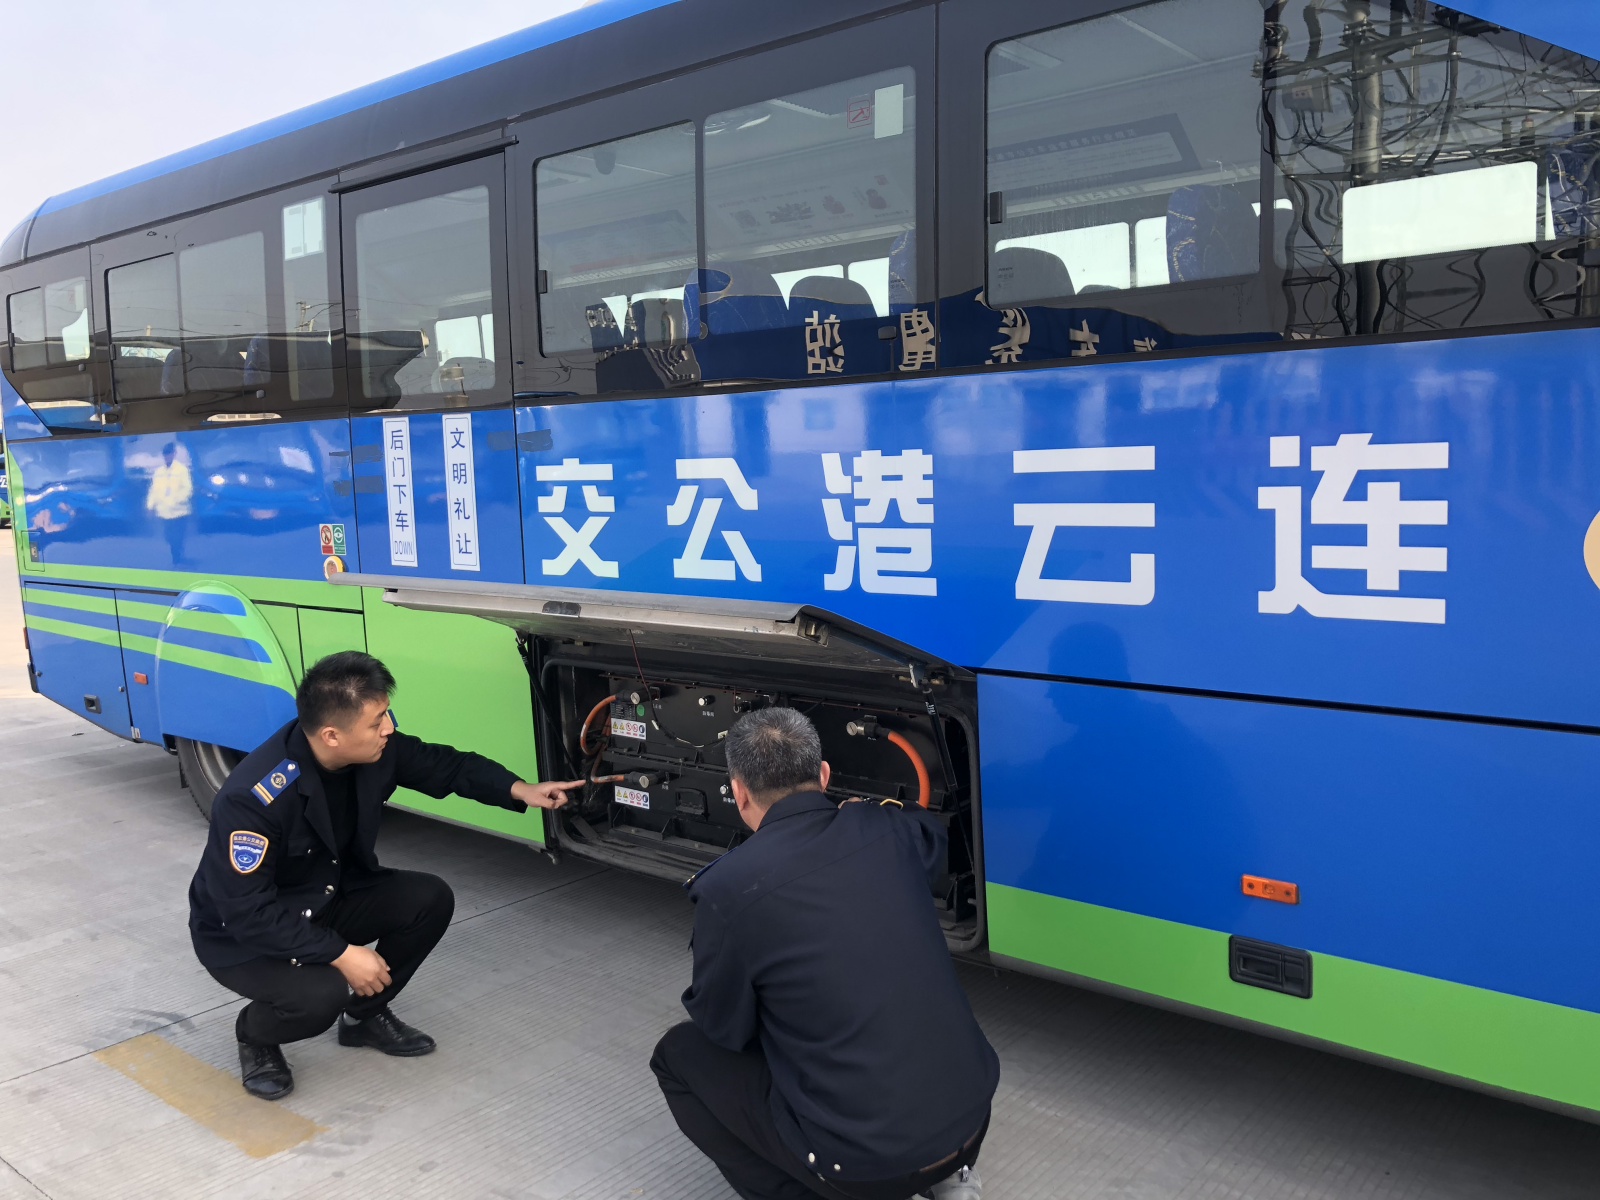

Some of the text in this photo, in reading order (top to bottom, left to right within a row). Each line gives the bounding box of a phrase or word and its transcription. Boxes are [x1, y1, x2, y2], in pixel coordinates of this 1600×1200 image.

[390, 429, 409, 532] 后门下车
[450, 427, 472, 555] 文明礼让
[394, 540, 413, 556] DOWN
